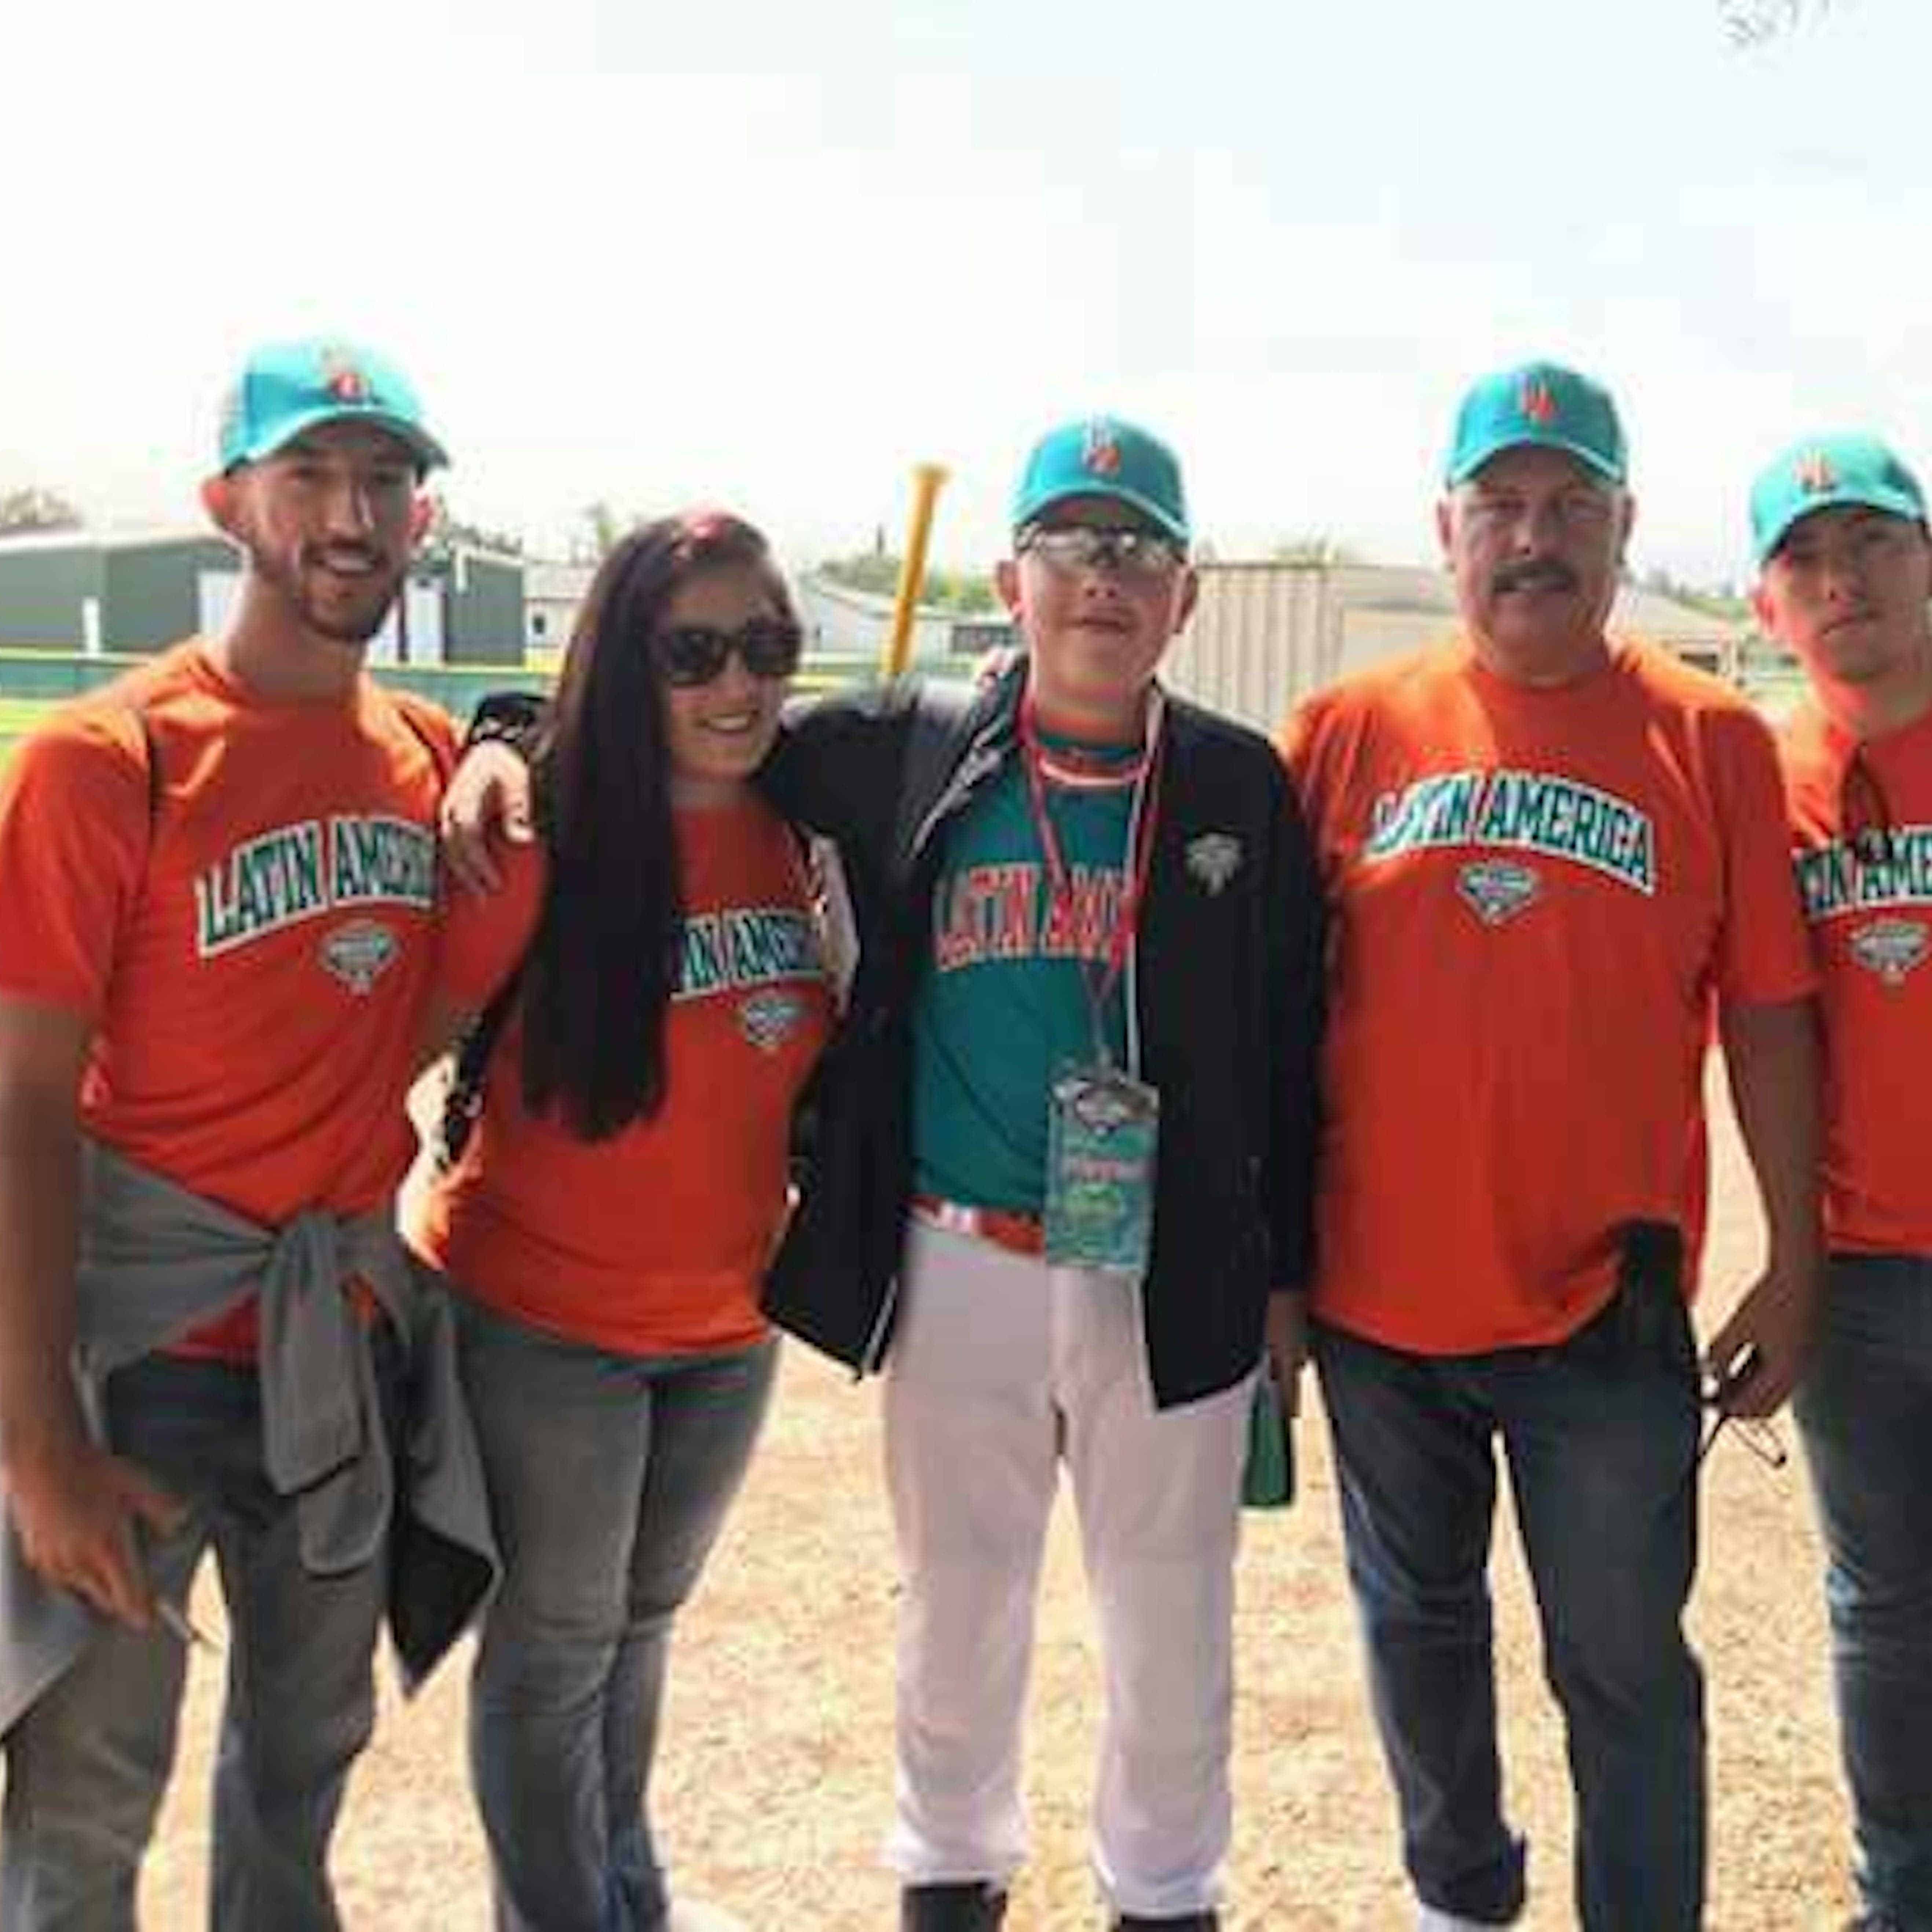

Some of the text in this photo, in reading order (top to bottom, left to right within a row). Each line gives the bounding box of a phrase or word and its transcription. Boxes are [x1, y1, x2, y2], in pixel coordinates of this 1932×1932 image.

[195, 820, 328, 958] LATIN
[1361, 767, 1482, 863] LATIN
[1475, 767, 1654, 896] AMERICA
[933, 863, 1040, 971] LATIN
